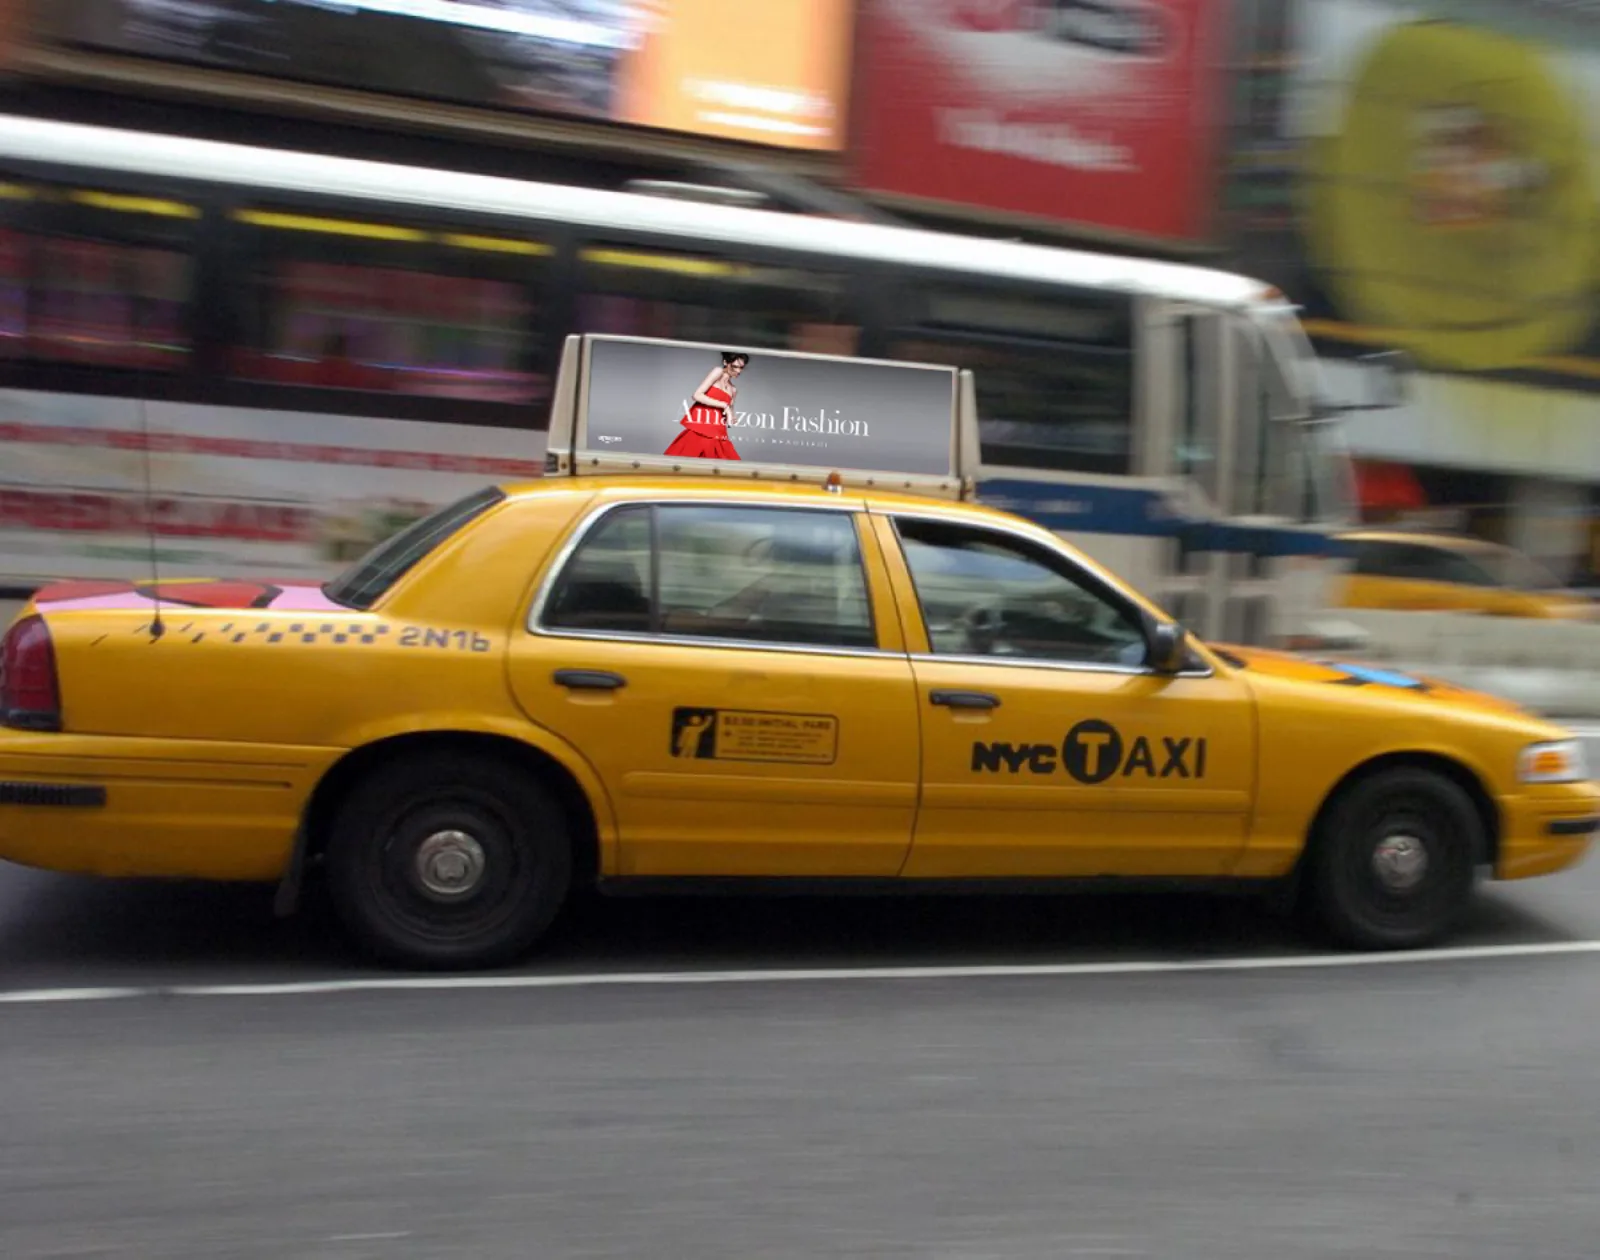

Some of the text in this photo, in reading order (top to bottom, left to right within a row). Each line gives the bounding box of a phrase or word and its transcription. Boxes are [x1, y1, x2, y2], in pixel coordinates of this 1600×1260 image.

[672, 398, 871, 438] Amazon Fashion
[971, 718, 1208, 785] NYC TAXI
